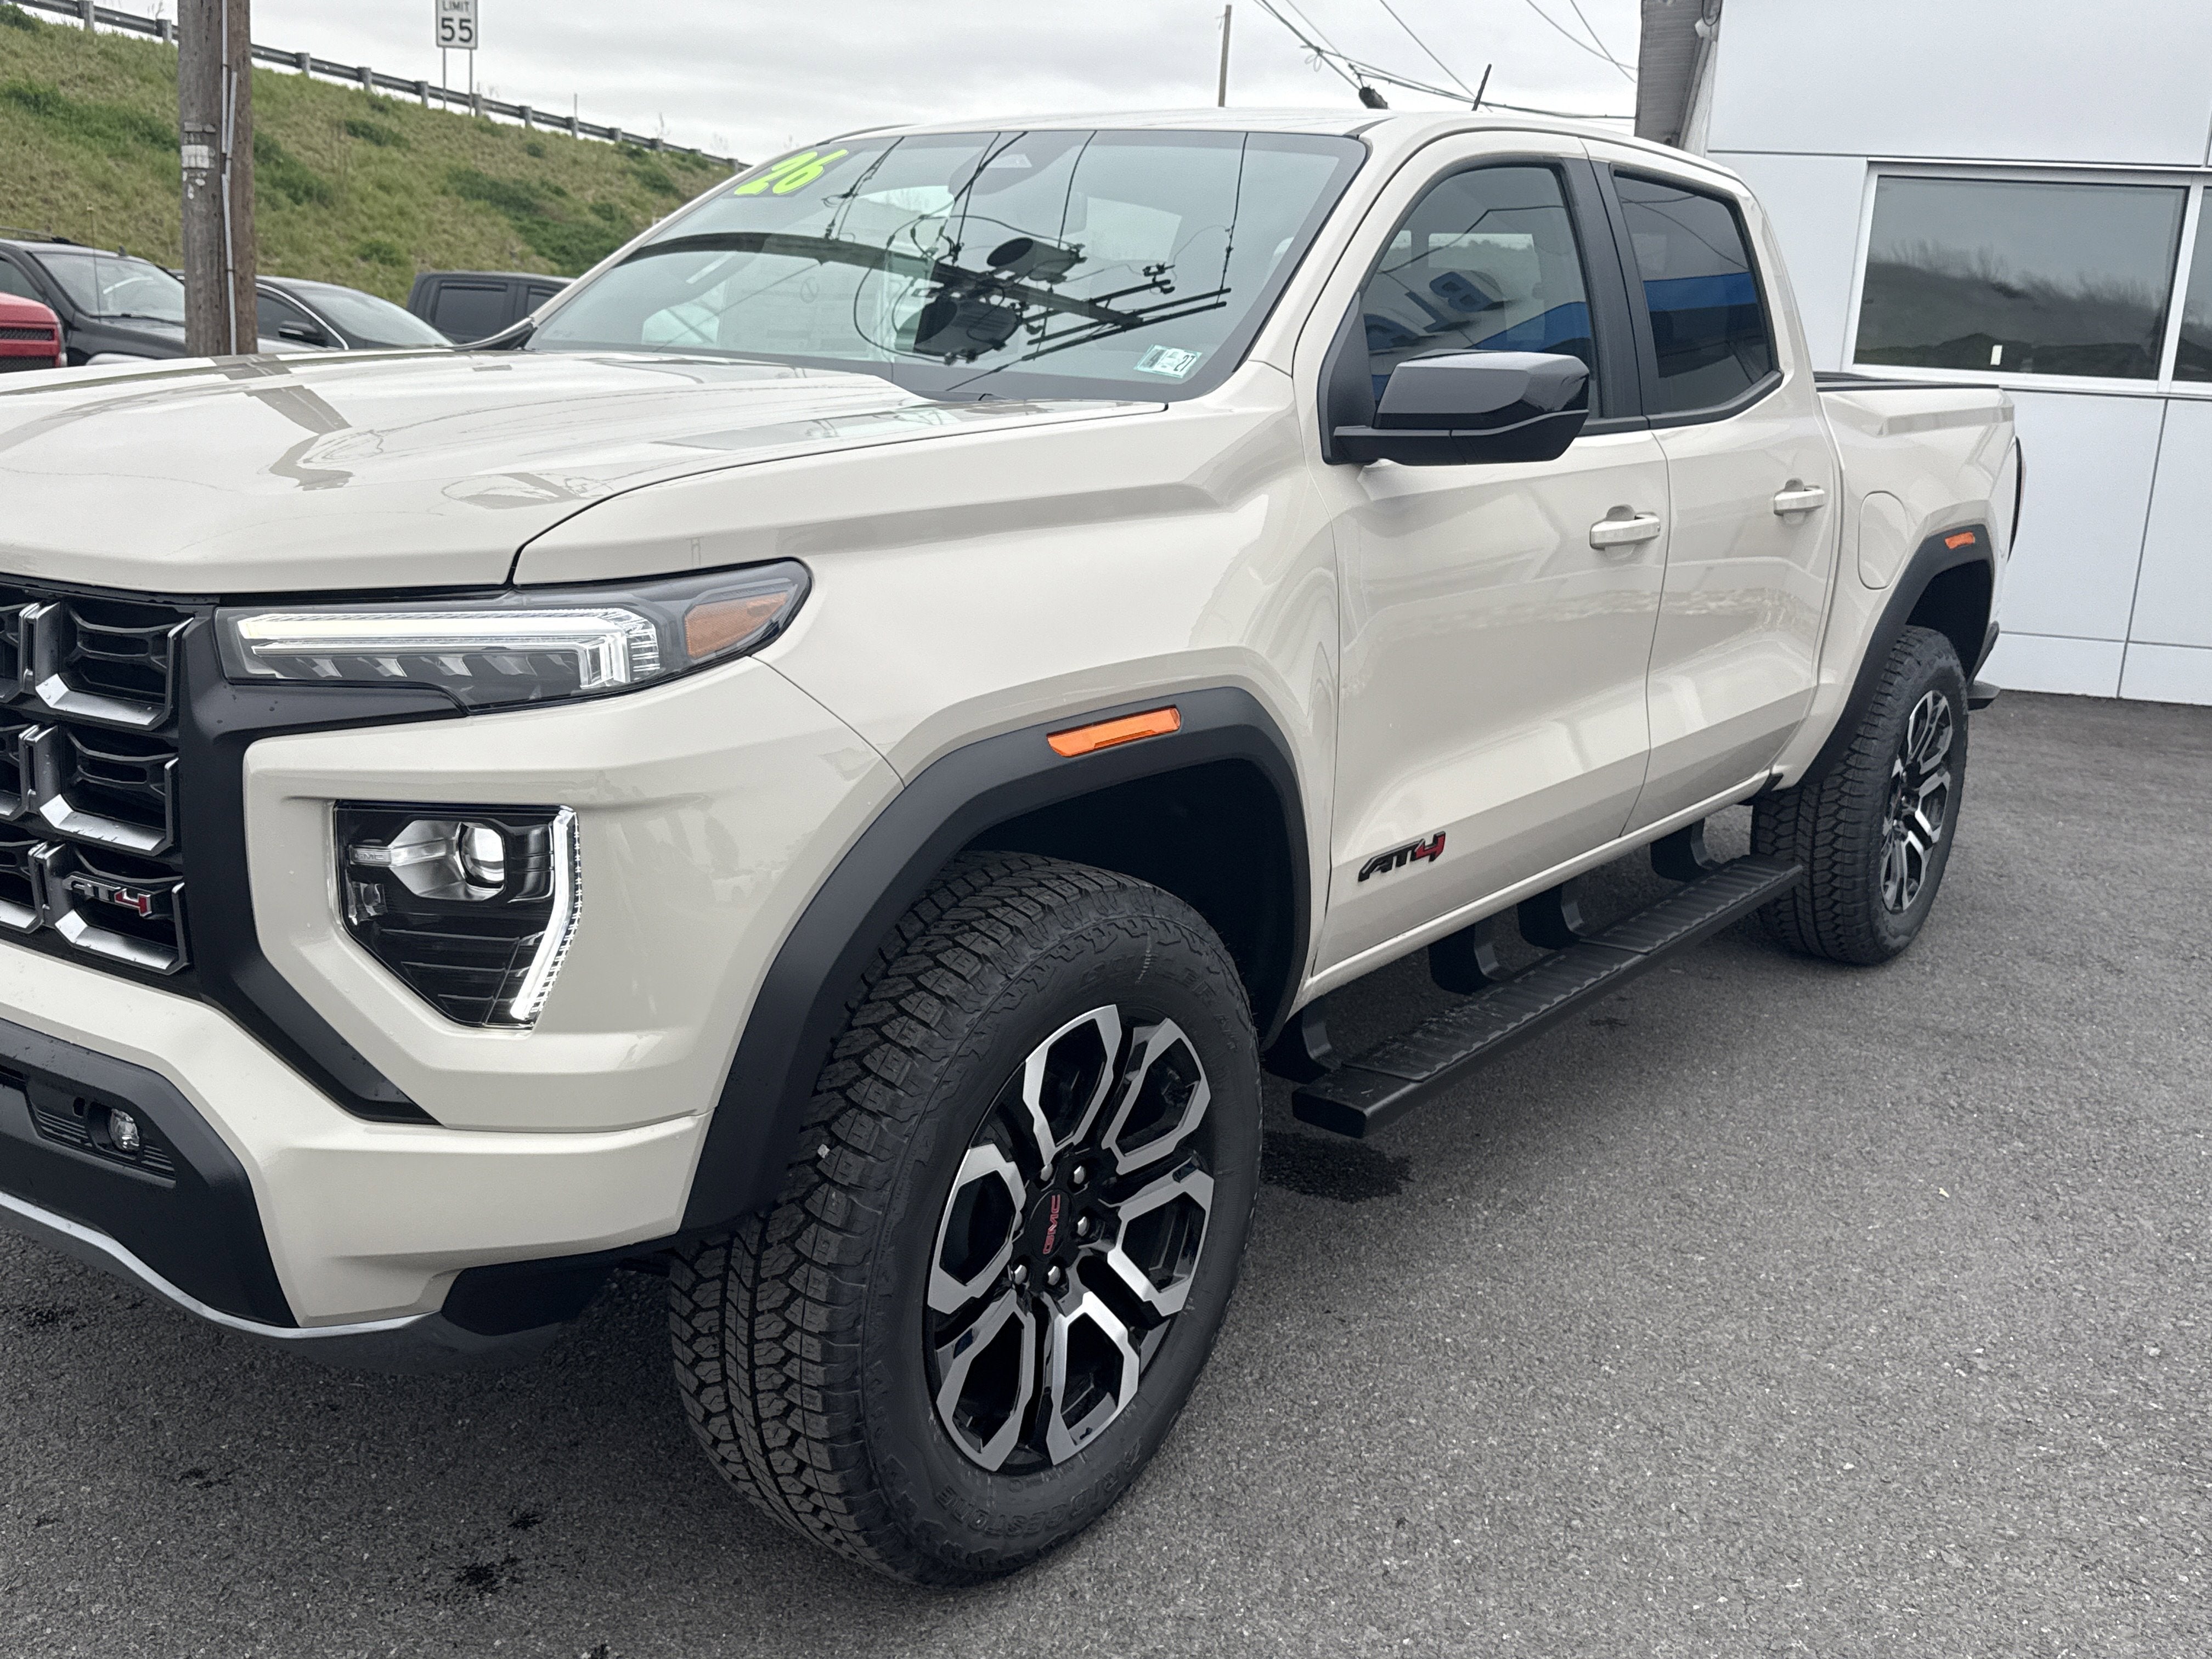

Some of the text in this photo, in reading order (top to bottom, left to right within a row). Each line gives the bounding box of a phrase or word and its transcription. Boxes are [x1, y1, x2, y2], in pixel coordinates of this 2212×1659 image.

[442, 1, 470, 12] LIMIT
[441, 18, 473, 43] 55
[734, 149, 849, 195] 26
[1173, 354, 1196, 373] 27
[1358, 831, 1446, 882] AT4
[61, 874, 153, 917] AT4
[1043, 1194, 1061, 1255] GMC
[934, 1437, 1142, 1540] BRIDGESTONE
